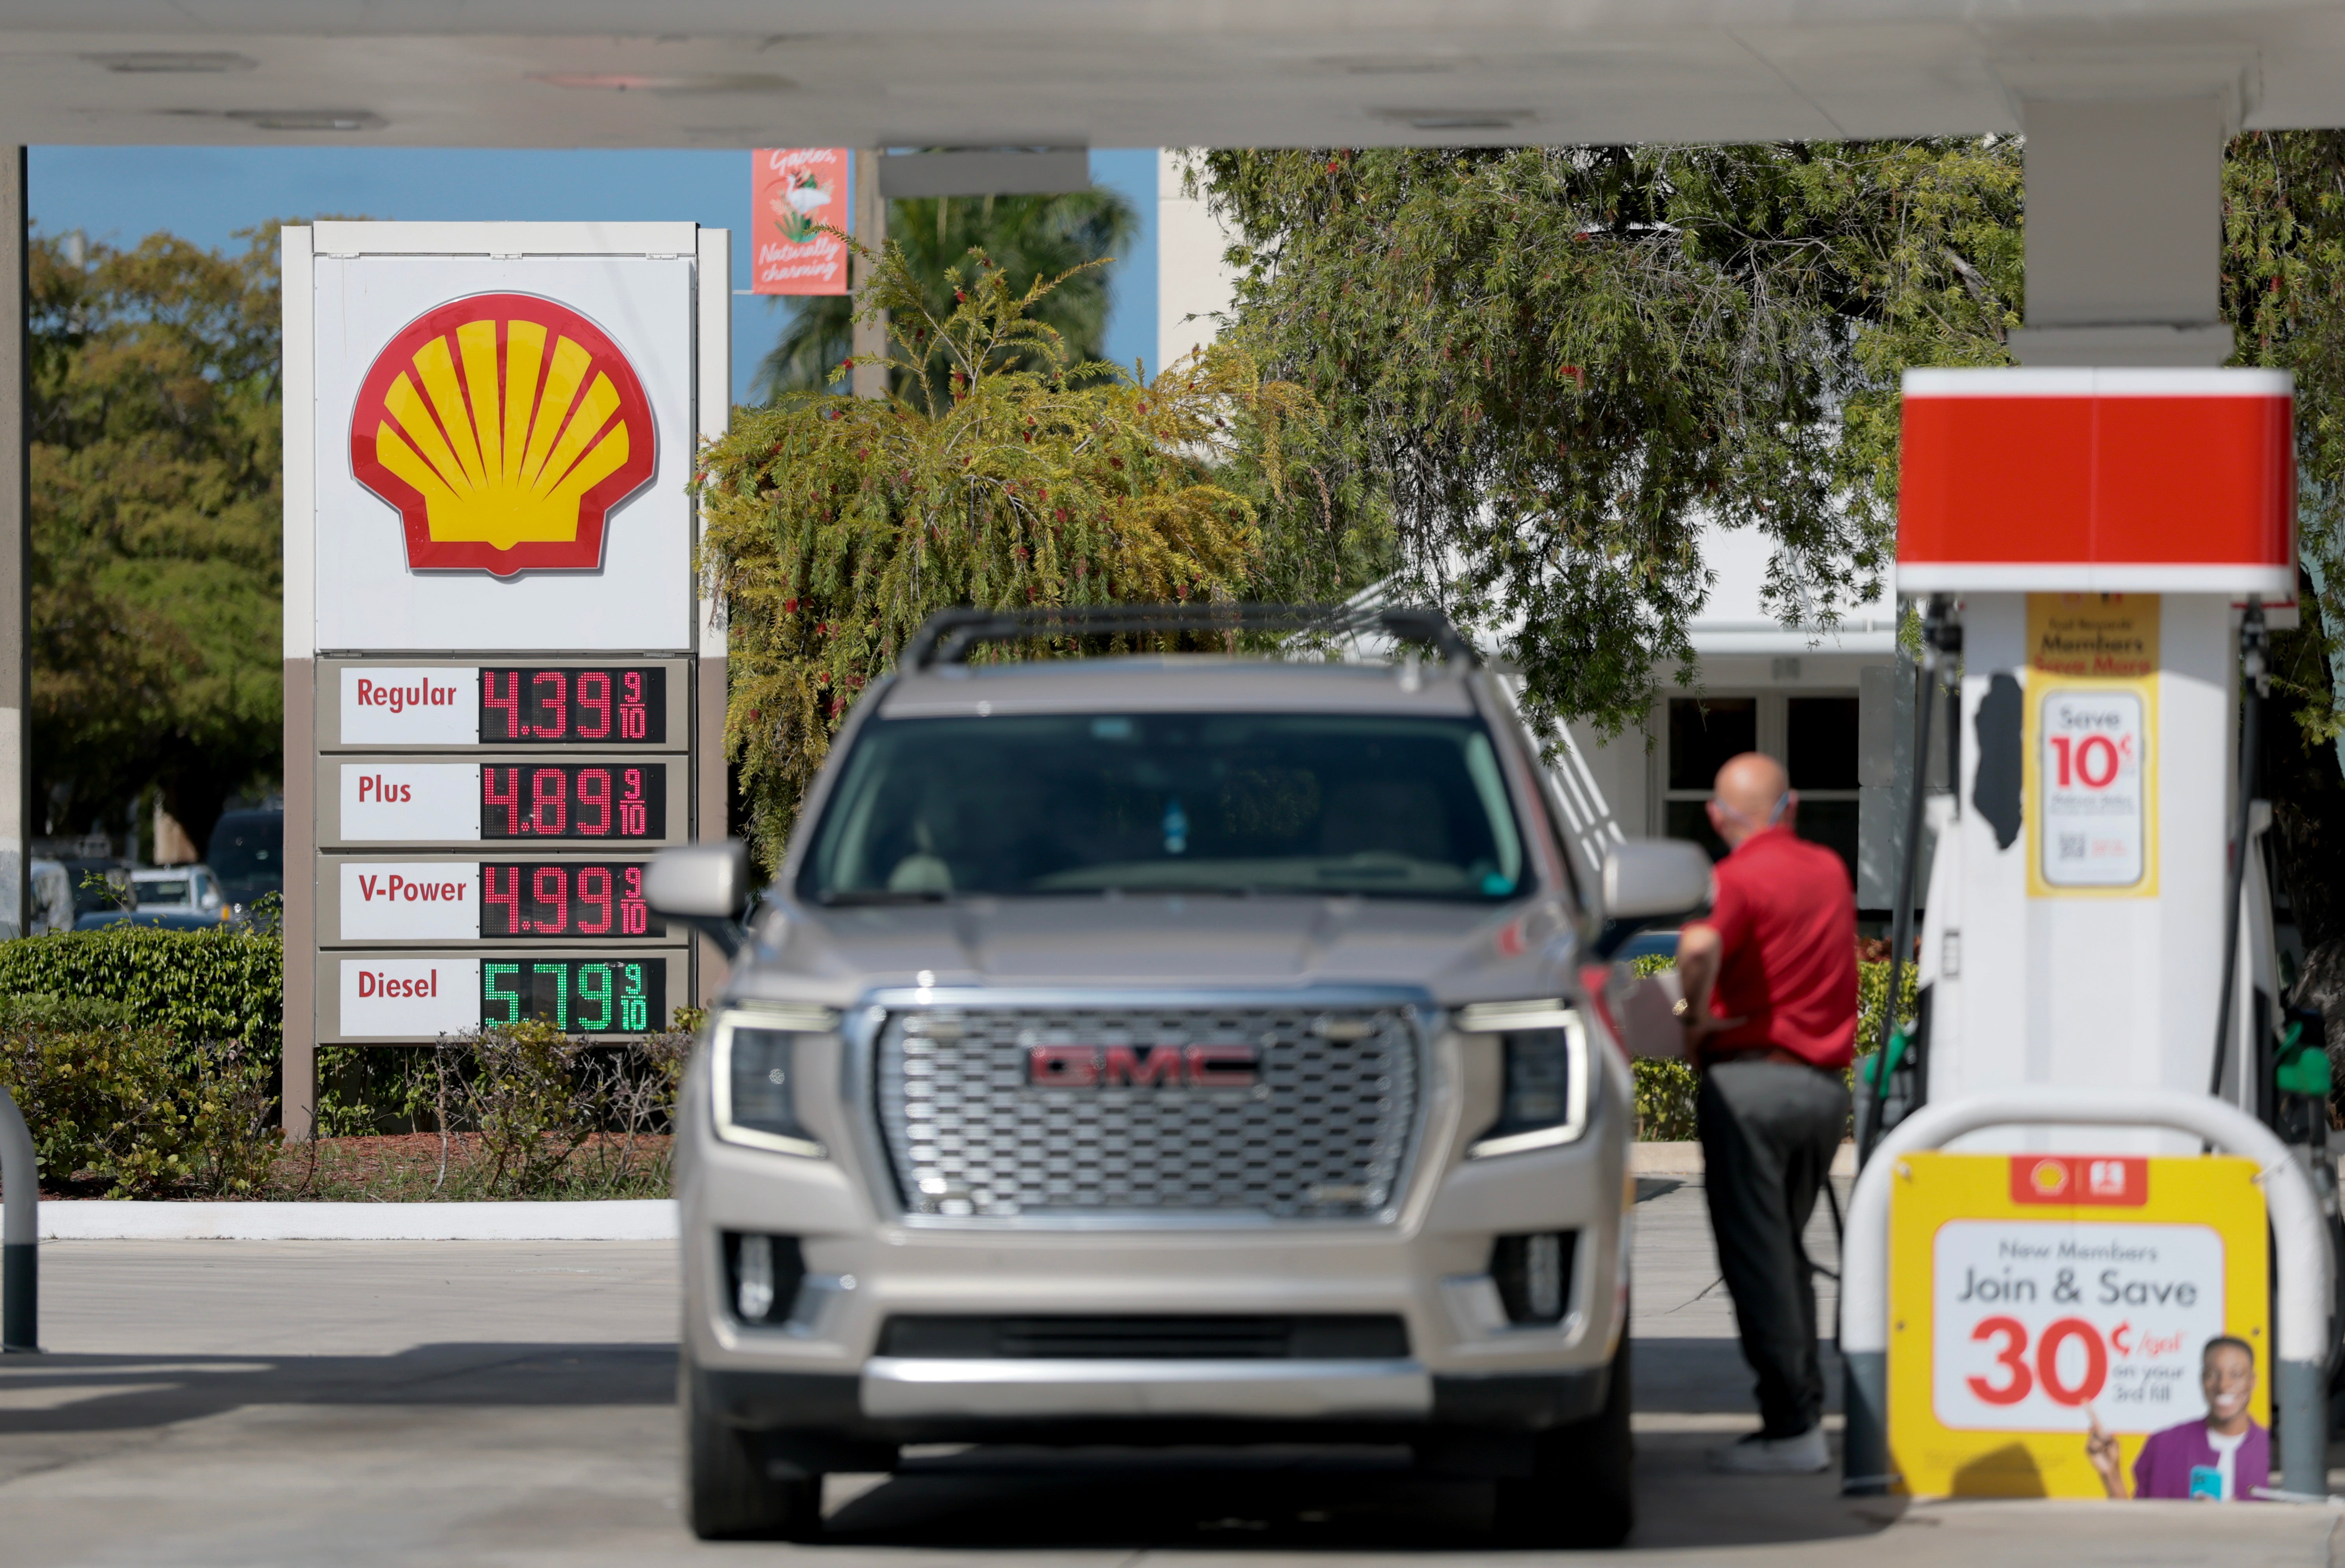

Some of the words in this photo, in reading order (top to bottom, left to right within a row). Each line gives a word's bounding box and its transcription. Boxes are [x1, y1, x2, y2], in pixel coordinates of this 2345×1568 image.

[759, 237, 840, 265] Naturally
[762, 261, 838, 282] charming
[2039, 630, 2145, 654] Members
[2093, 655, 2150, 677] More
[357, 678, 456, 713] Regular
[484, 671, 611, 738] 4.39
[2060, 706, 2120, 729] Save
[359, 775, 411, 802] Plus
[484, 768, 611, 835] 4.89
[359, 874, 467, 901] V-Power
[485, 867, 612, 934] 4.99
[359, 969, 437, 998] Diesel
[1029, 1045, 1259, 1088] GMC
[1999, 1239, 2050, 1260] New
[2057, 1239, 2157, 1261] Members
[1957, 1265, 2038, 1303] Join
[2052, 1268, 2083, 1304] &
[2098, 1268, 2198, 1307] Save
[2112, 1365, 2136, 1378] on
[2140, 1364, 2185, 1387] your
[2113, 1383, 2144, 1403] 3rd
